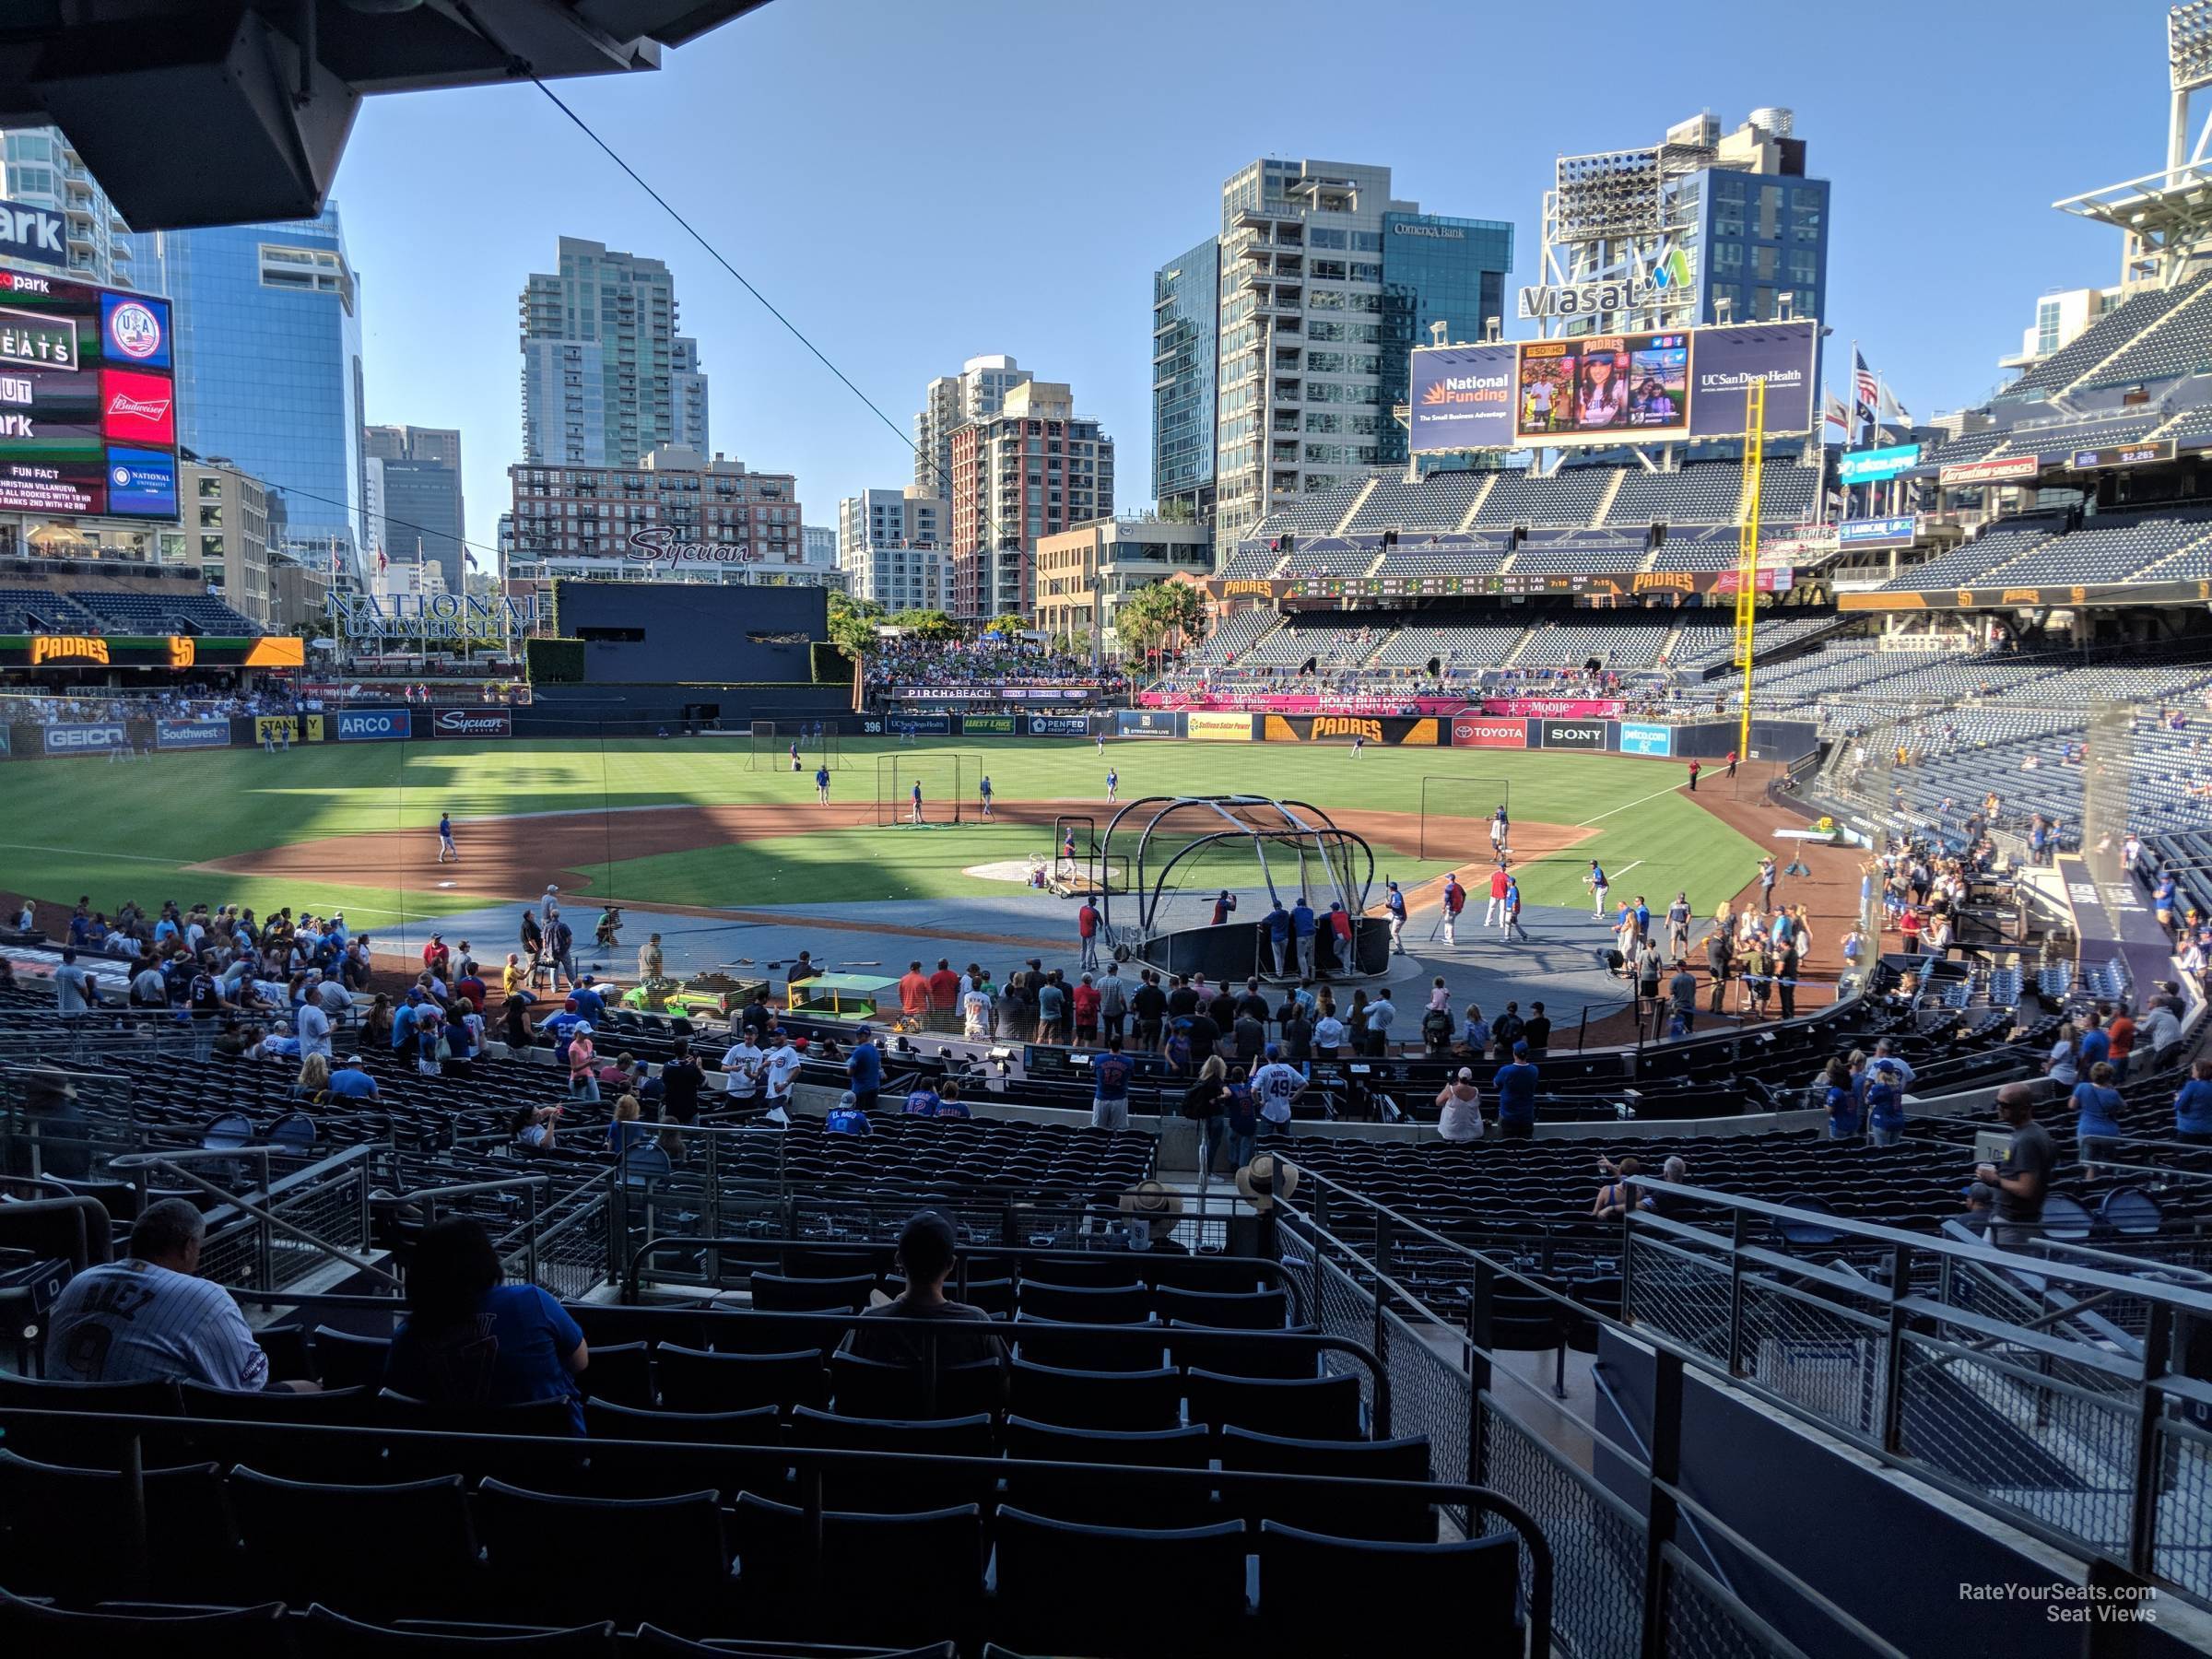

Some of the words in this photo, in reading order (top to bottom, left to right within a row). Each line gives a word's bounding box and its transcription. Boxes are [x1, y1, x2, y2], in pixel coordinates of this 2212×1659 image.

[1441, 227, 1465, 238] Bank
[14, 276, 50, 293] park
[1524, 278, 1640, 316] Viasat
[1583, 338, 1625, 356] PADRES
[1446, 373, 1509, 390] National
[1701, 374, 1718, 385] UC
[1719, 373, 1738, 384] San
[1739, 372, 1768, 385] Diego
[1769, 370, 1801, 381] Health
[1446, 389, 1508, 403] Funding
[114, 397, 165, 415] Budweiser
[2123, 450, 2155, 462] $2,265
[13, 466, 32, 477] FUN
[35, 468, 59, 479] FACT
[132, 471, 171, 482] NATIONAL
[1941, 465, 1991, 481] Tarantino
[1992, 462, 2033, 476] SAUSAGES
[6, 488, 18, 497] ALL
[20, 490, 52, 500] ROOKIES
[53, 492, 70, 500] WITH
[35, 482, 76, 493] VILLANUEVA
[4, 498, 28, 506] RANKS
[29, 499, 44, 507] 2ND
[44, 500, 63, 509] WITH
[628, 526, 752, 570] Sycuan
[1223, 581, 1272, 597] PADRES
[1632, 572, 1695, 592] PADRES
[2002, 590, 2040, 604] PADRES
[324, 592, 546, 620] NATIONAL
[344, 619, 530, 639] UNIVERSITY
[33, 636, 110, 665] PADRES
[908, 689, 948, 698] PIRCH
[956, 689, 992, 698] BEACH
[1319, 696, 1354, 708] HOME
[1356, 697, 1381, 709] RUN
[1383, 698, 1416, 709] DECK
[260, 719, 318, 732] STANLY
[341, 717, 391, 734] ARCO
[435, 711, 503, 732] Sycuan
[864, 721, 881, 734] 396
[1047, 720, 1085, 728] PENFED
[1198, 721, 1219, 729] Sullivan
[1219, 722, 1234, 730] Solar
[161, 727, 218, 740] Southwest
[1311, 716, 1382, 742] PADRES
[1474, 727, 1523, 738] TOYOTA
[1551, 728, 1602, 740] SONY
[1624, 729, 1667, 742] petco.com
[49, 728, 124, 747] GEICO
[195, 986, 206, 1001] 5
[1270, 1079, 1290, 1098] 49
[907, 1100, 926, 1113] 12
[49, 1278, 60, 1296] D
